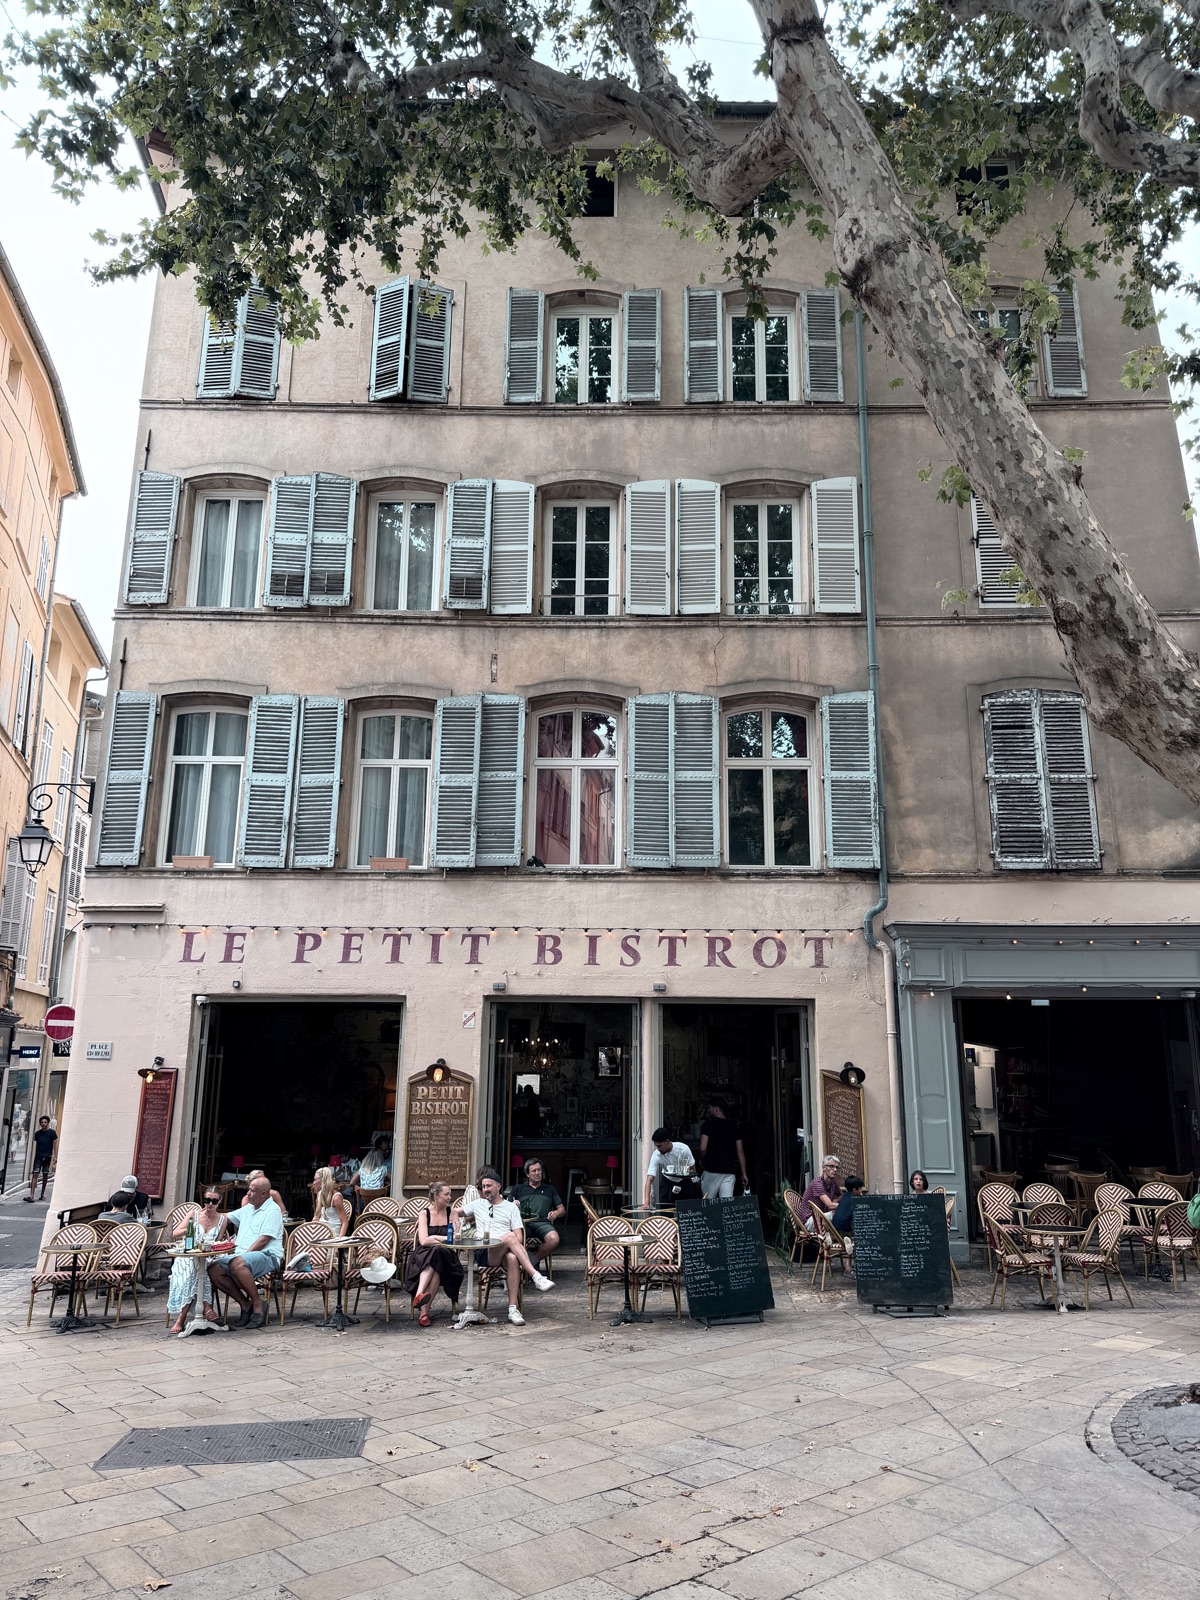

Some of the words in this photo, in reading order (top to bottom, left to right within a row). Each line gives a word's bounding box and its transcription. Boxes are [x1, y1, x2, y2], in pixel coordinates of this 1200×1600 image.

[178, 932, 247, 963] LE
[290, 932, 490, 965] PETIT
[532, 934, 834, 968] BISTROT
[416, 1086, 465, 1100] PETIT
[410, 1101, 469, 1115] BISTROT
